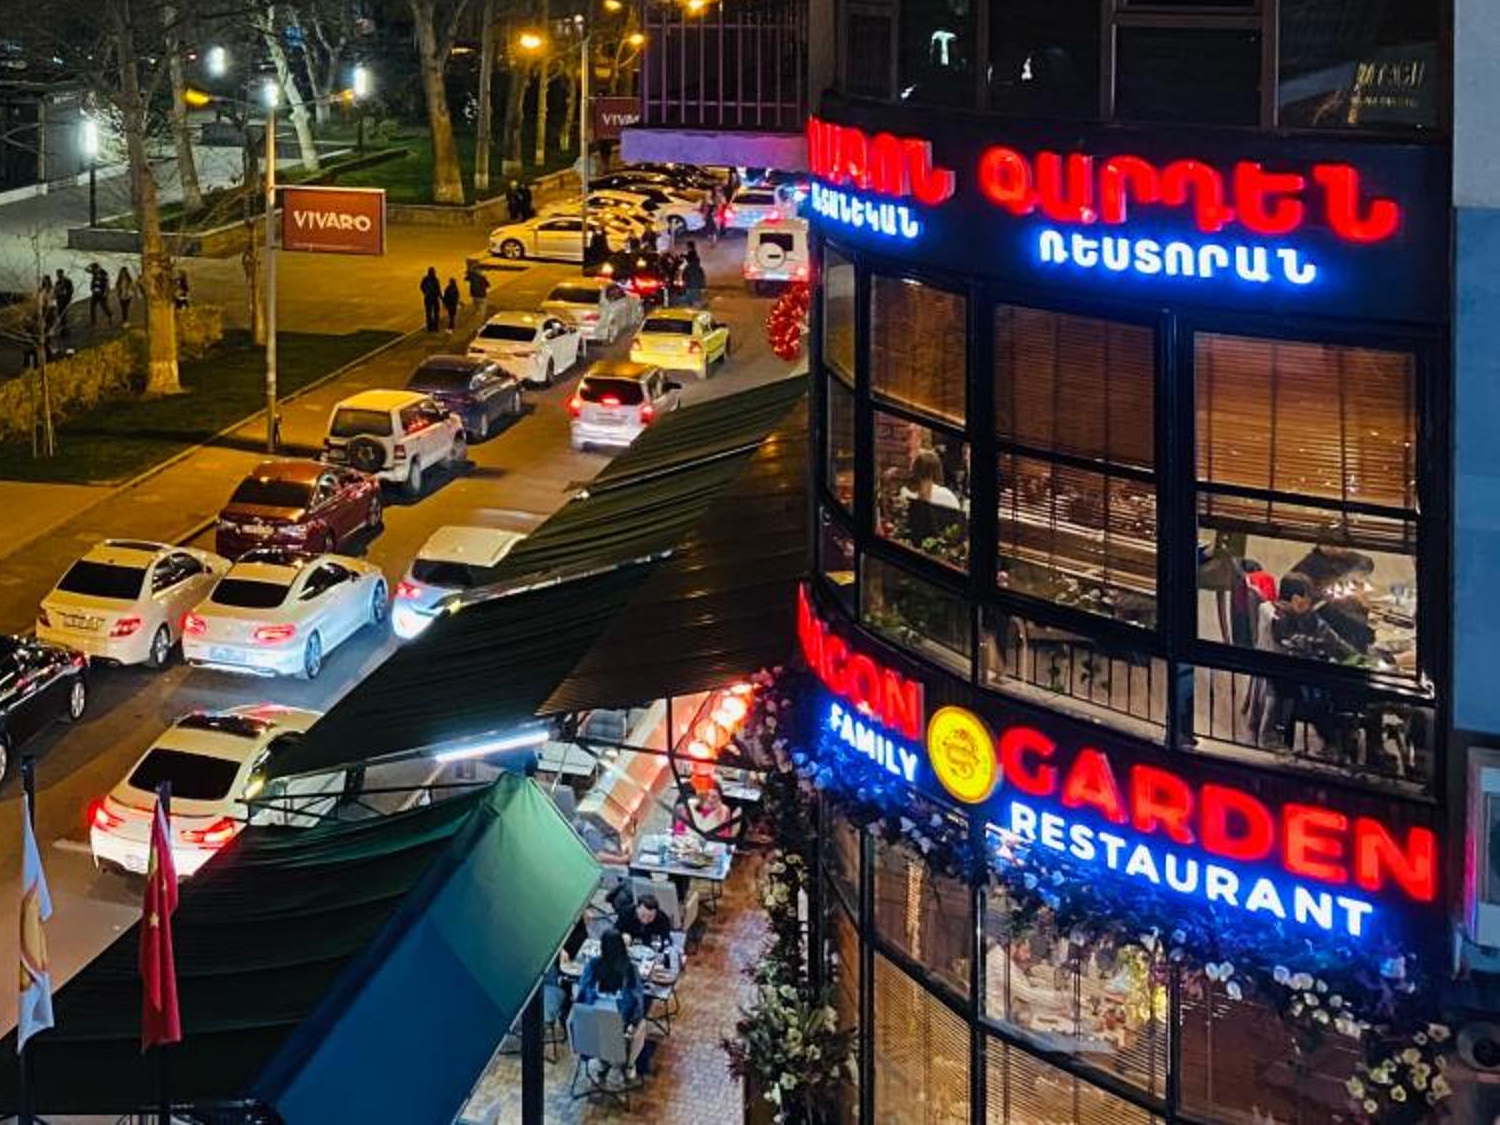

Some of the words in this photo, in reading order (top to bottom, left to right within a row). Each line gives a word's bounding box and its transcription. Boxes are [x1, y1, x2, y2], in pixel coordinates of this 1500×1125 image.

[293, 210, 371, 232] VIVARO
[978, 145, 1400, 243] ԳԱՐԴԵՆ
[1038, 230, 1317, 284] ՌԵՍՏՈՐԱՆ
[830, 703, 919, 782] FAMILY
[1010, 800, 1374, 937] RESTAURANT
[999, 728, 1438, 902] GARDEN
